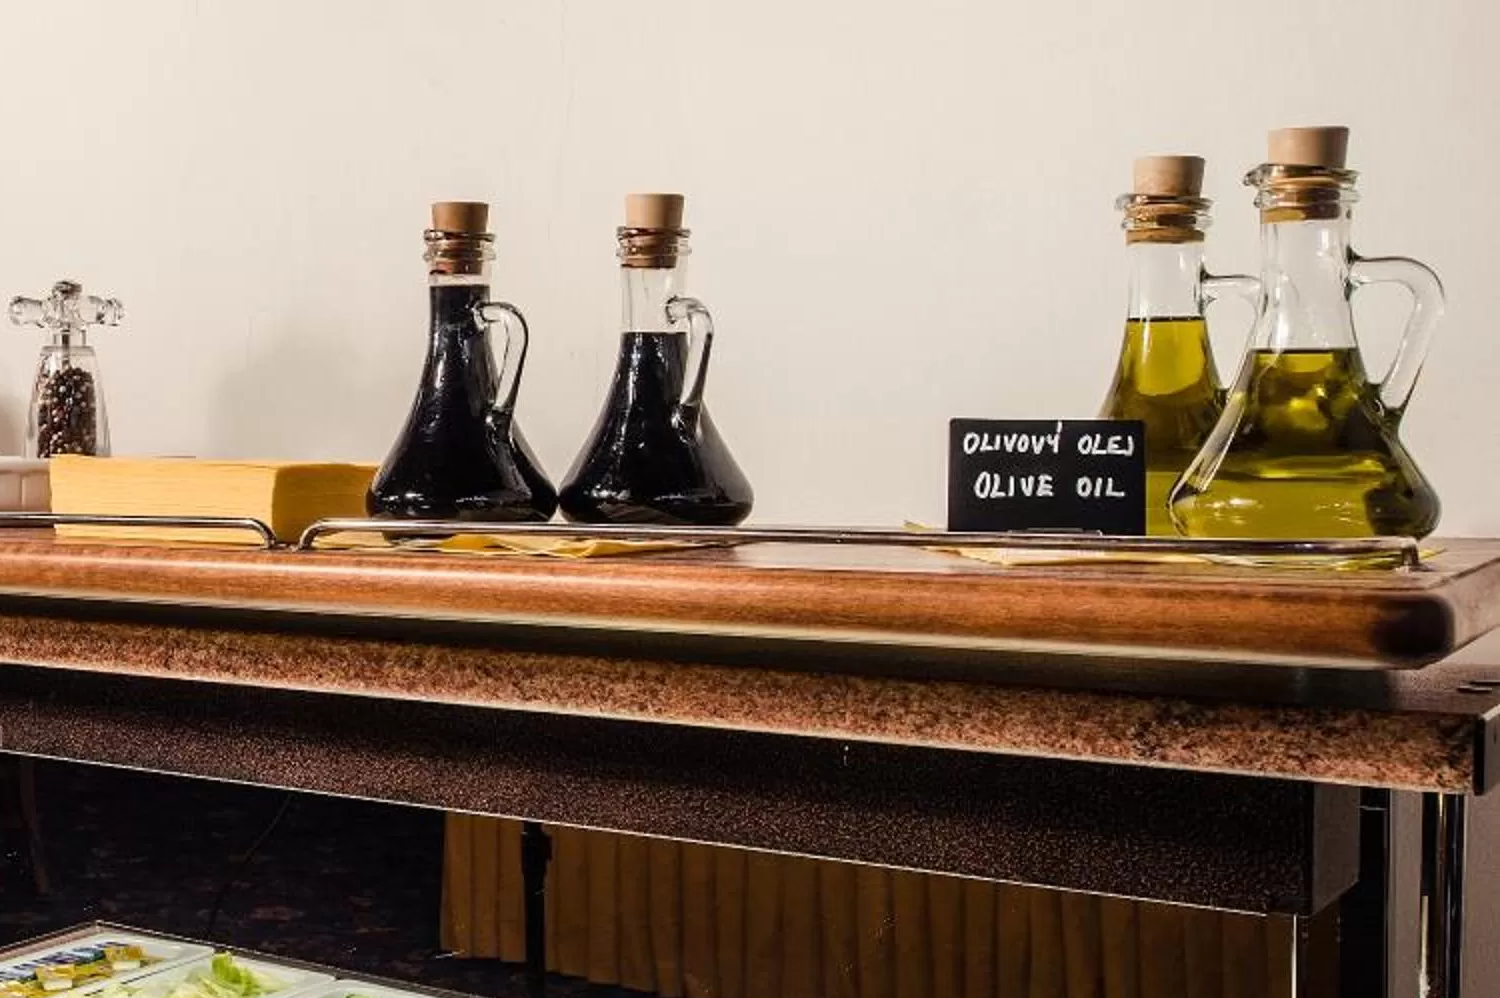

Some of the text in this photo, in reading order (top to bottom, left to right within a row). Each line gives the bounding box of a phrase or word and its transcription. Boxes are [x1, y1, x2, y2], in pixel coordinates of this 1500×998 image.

[963, 421, 1134, 456] OLIVOVÝ OLEJ
[974, 471, 1125, 499] OLIVE OIL
